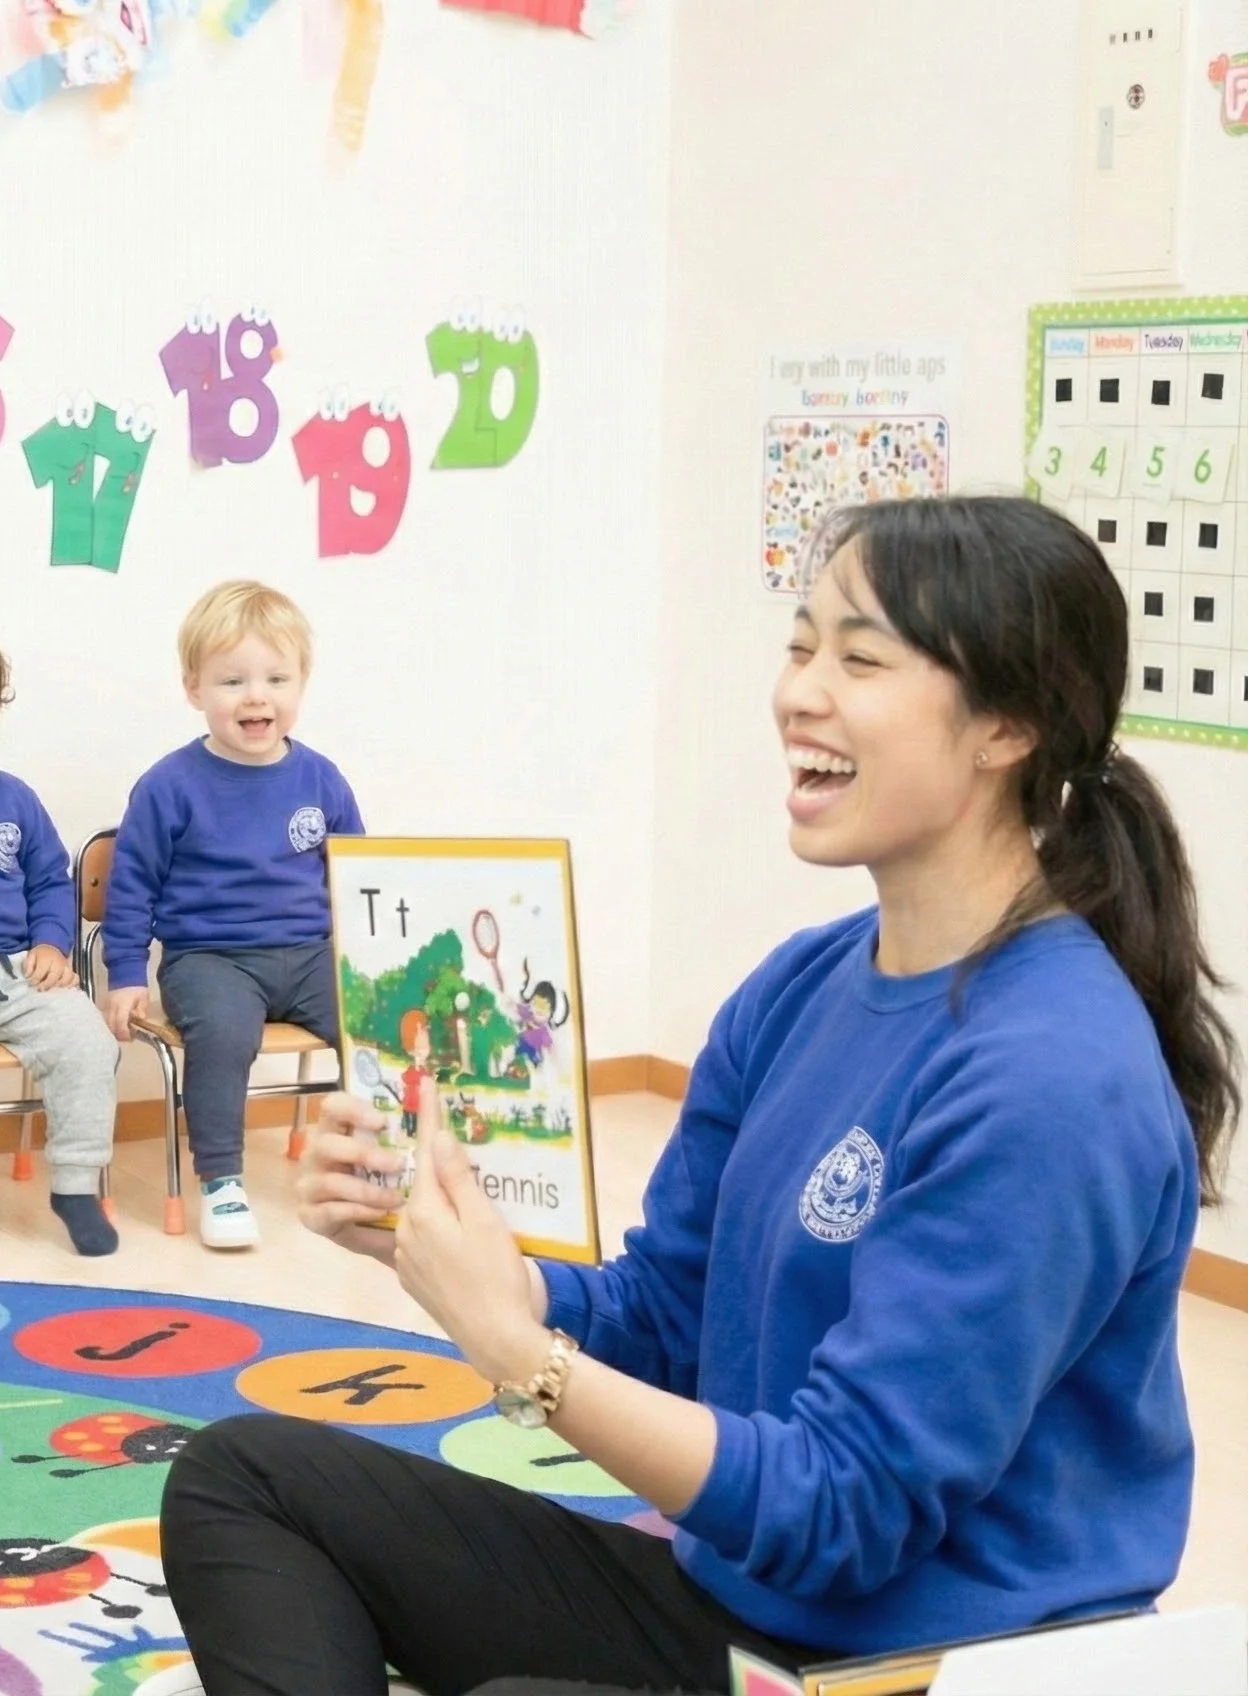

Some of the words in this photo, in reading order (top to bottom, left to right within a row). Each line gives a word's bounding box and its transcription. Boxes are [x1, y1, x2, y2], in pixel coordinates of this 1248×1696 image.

[846, 358, 869, 383] my
[875, 350, 911, 377] little
[1145, 333, 1184, 351] Tuesday
[158, 312, 279, 468] 18
[425, 320, 538, 468] 20
[22, 403, 156, 573] 17
[291, 401, 412, 558] 19
[1044, 447, 1062, 476] 3
[1090, 446, 1108, 477] 4
[1146, 446, 1165, 478] 5
[1194, 447, 1212, 484] 6
[360, 888, 380, 936] T
[395, 898, 410, 938] t
[75, 1322, 190, 1361] j
[300, 1363, 426, 1406] k
